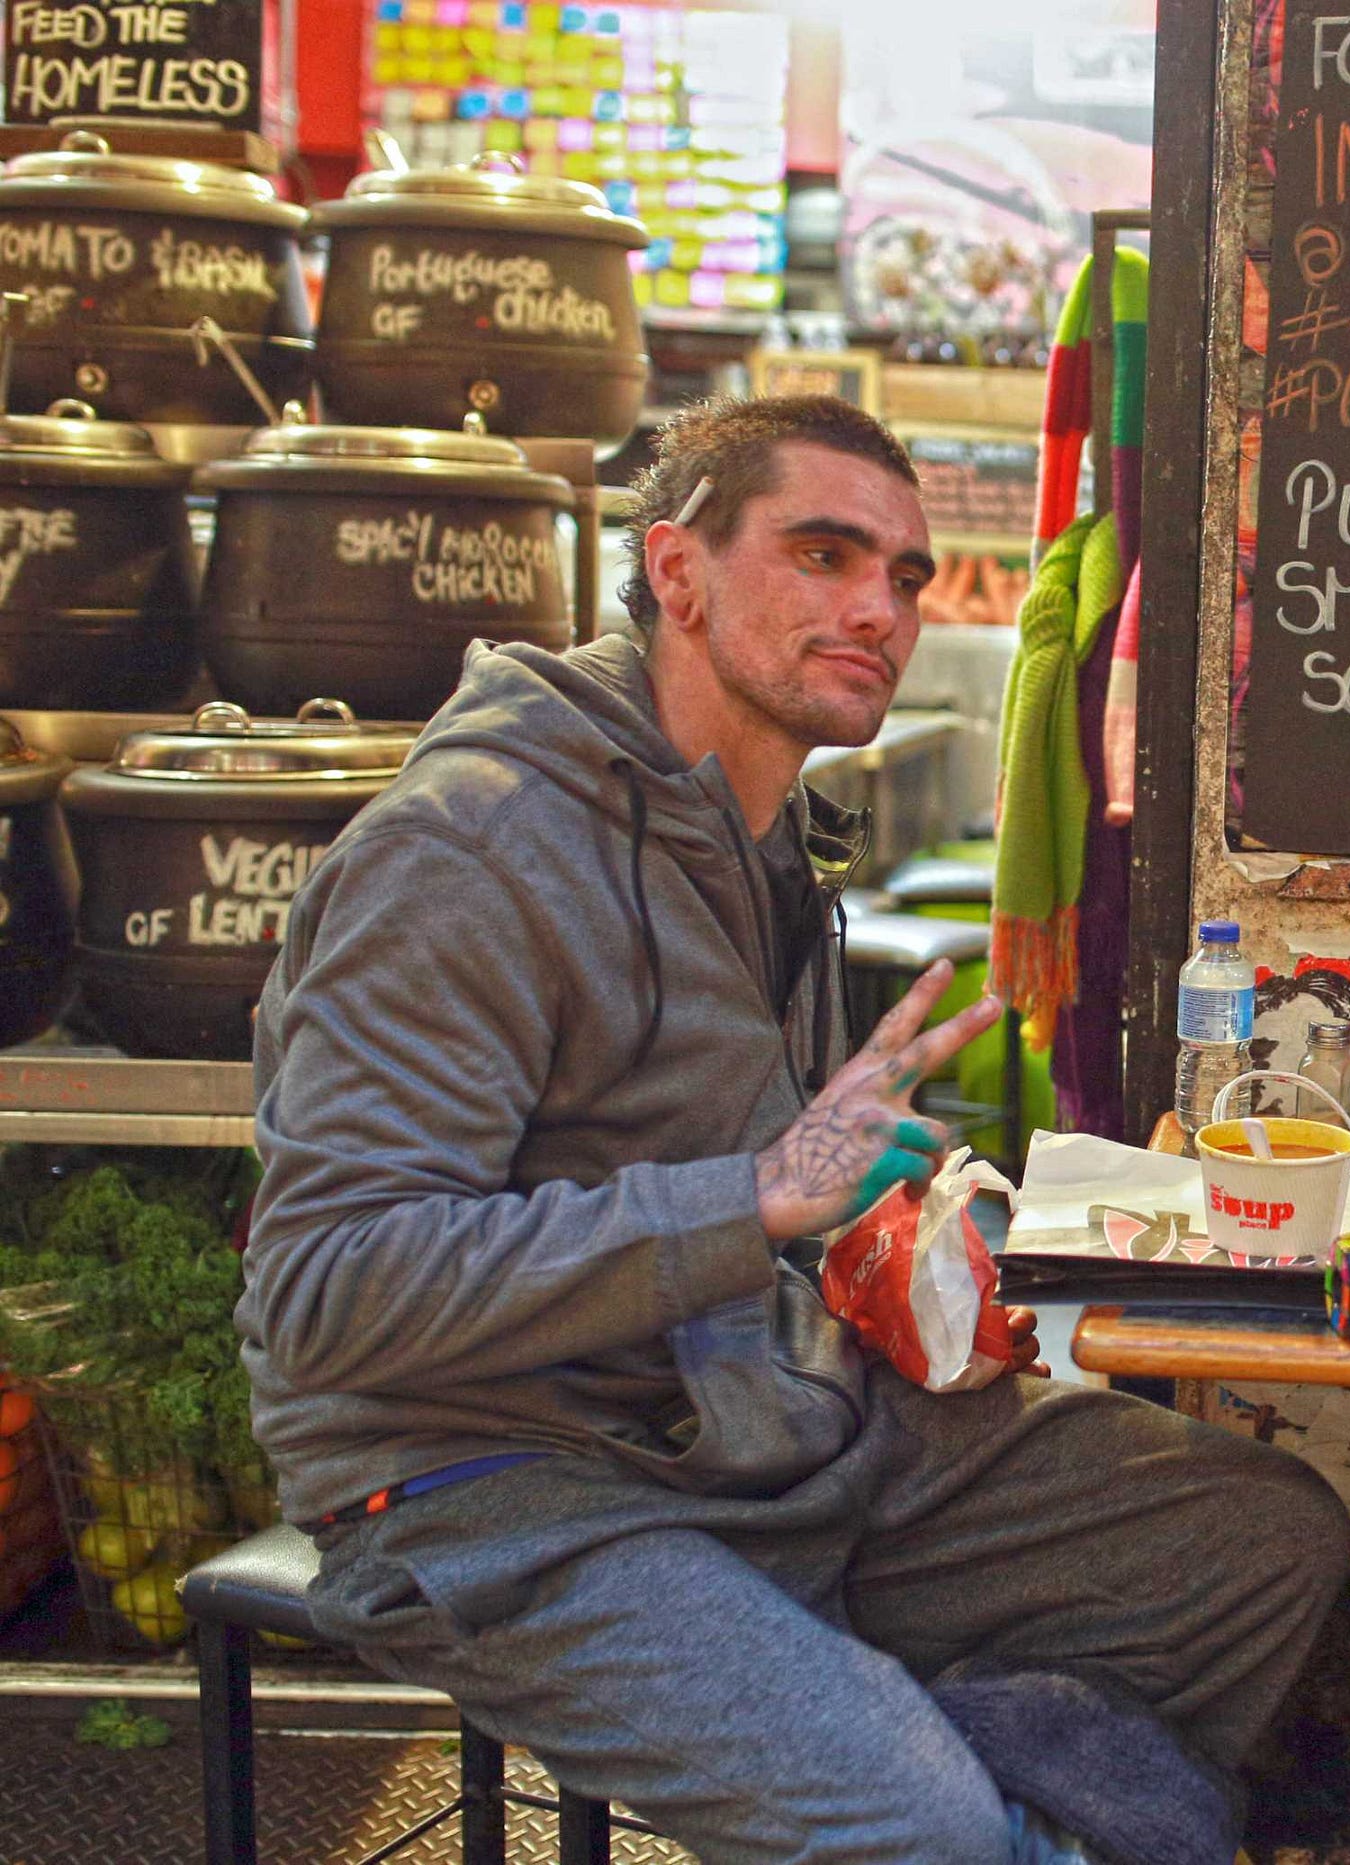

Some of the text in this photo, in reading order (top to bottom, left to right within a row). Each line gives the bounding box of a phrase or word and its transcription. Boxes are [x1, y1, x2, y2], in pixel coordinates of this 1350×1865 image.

[13, 2, 188, 47] FEED THE
[13, 53, 249, 116] HOMELESS
[372, 302, 422, 341] GF
[336, 512, 433, 564] SPICY
[124, 909, 173, 946] GF
